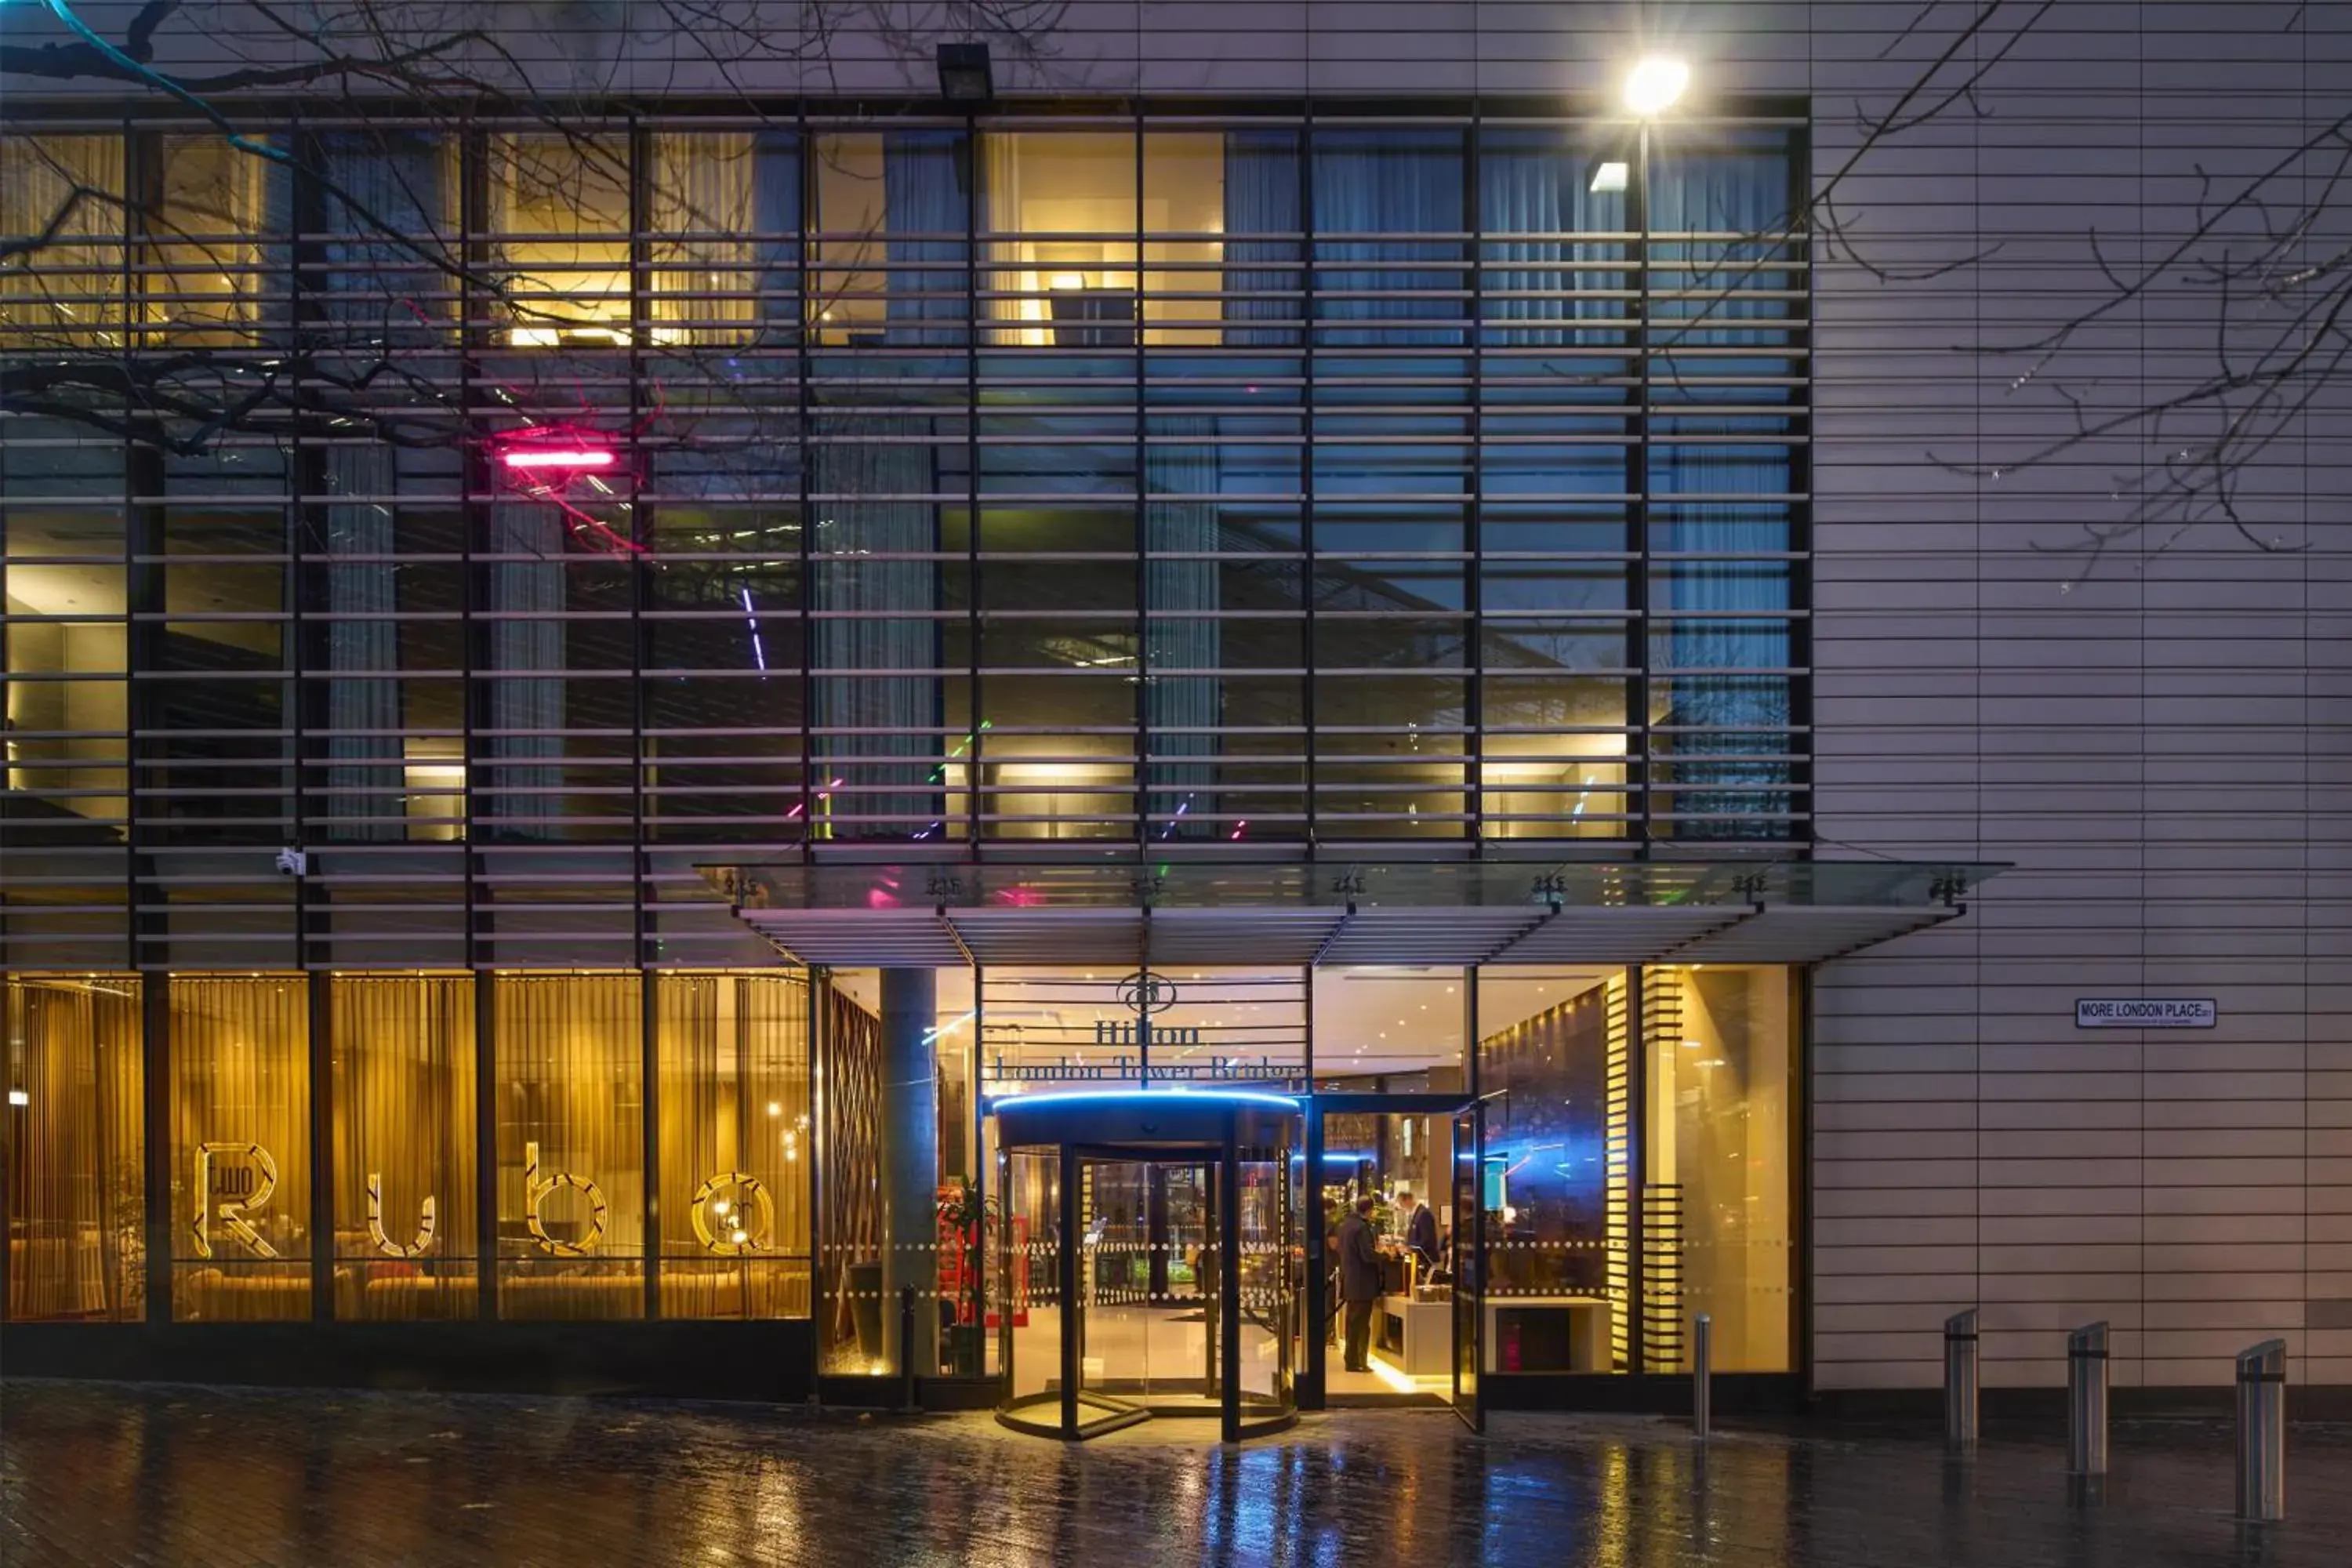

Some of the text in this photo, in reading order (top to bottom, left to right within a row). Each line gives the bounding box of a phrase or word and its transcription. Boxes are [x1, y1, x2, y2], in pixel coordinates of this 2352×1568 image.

[2081, 1004, 2114, 1017] MORE
[2116, 1004, 2164, 1017] LONDON
[2165, 1004, 2201, 1017] PLACE
[1095, 1019, 1200, 1046] Hilton
[996, 1055, 1102, 1080] London
[1112, 1055, 1202, 1080] Tower
